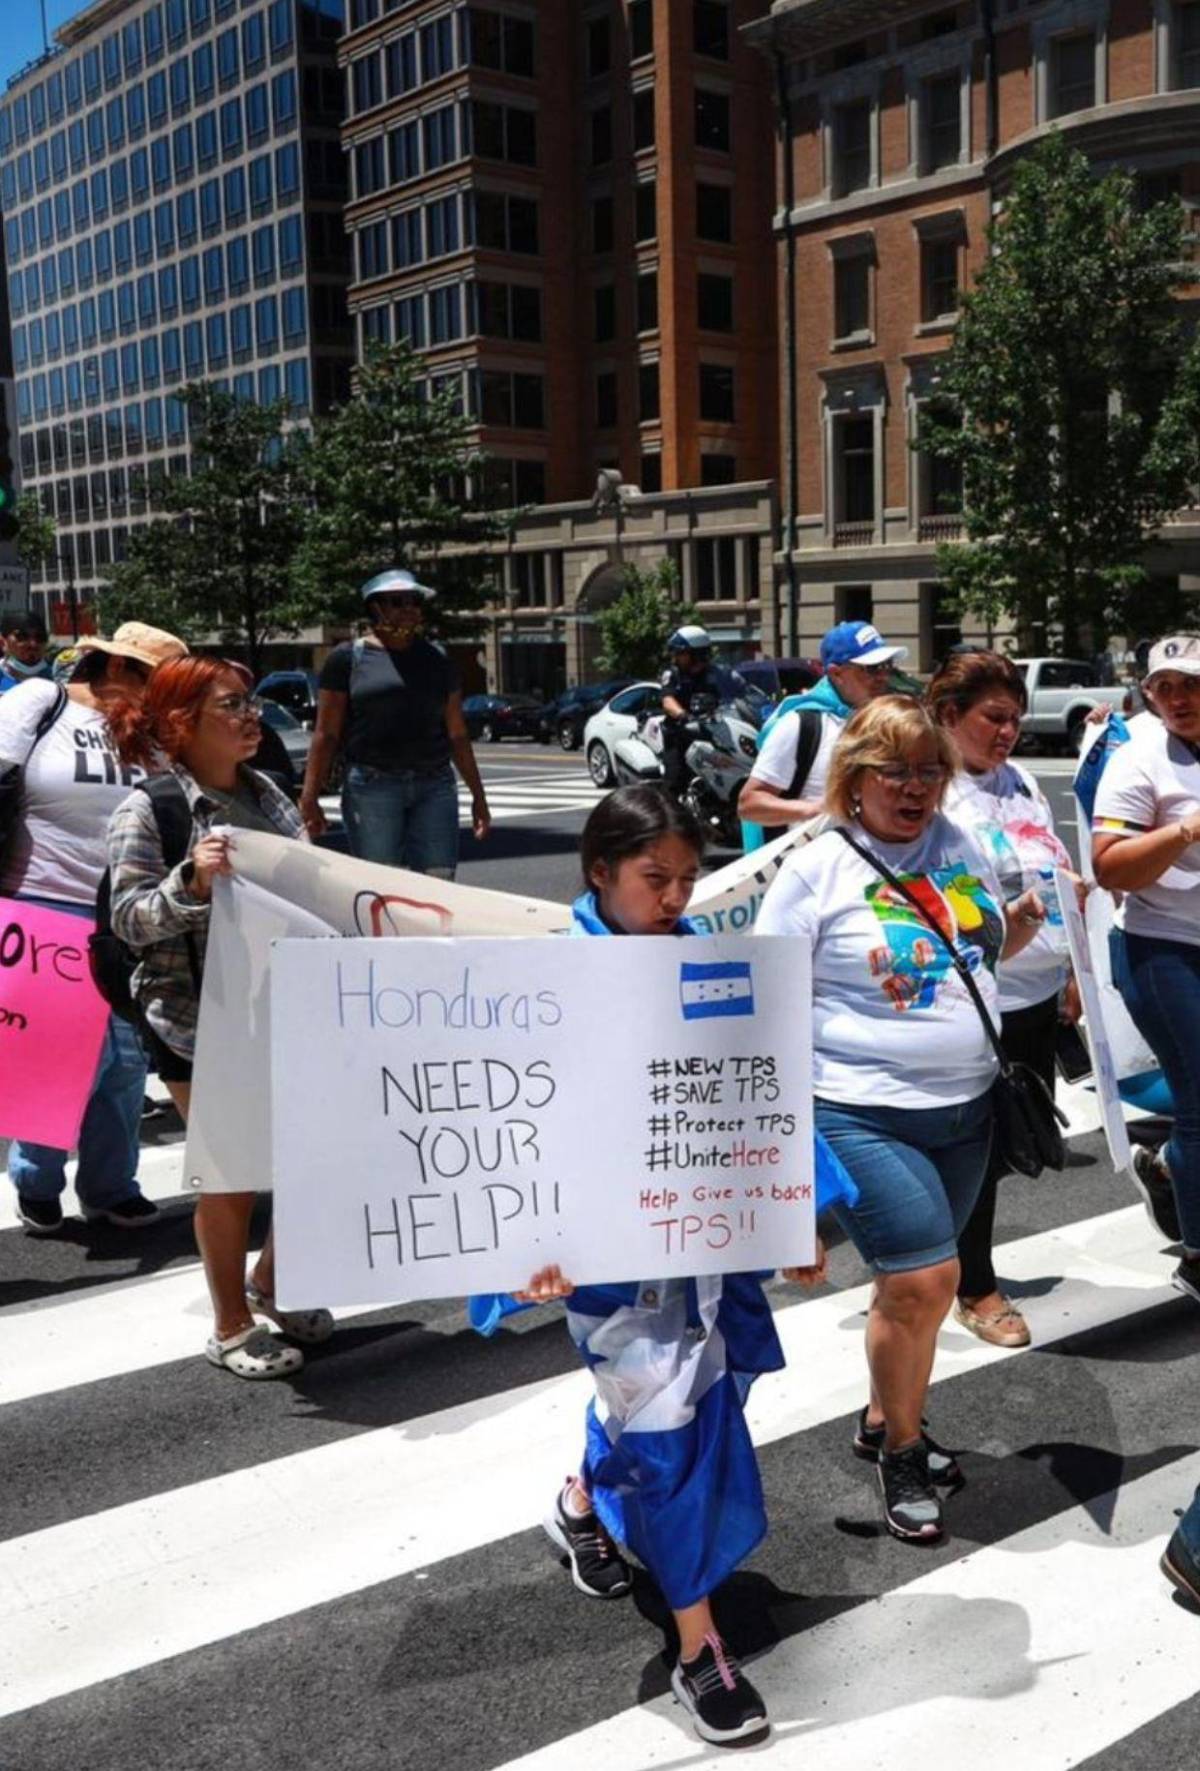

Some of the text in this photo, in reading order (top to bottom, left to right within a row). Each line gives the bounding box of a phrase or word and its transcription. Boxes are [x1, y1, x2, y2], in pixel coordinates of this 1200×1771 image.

[73, 728, 108, 750] CH
[692, 892, 765, 933] arol
[337, 959, 563, 1033] Honduras
[729, 1056, 776, 1077] TPS
[381, 1058, 556, 1116] NEEDS
[735, 1075, 781, 1102] TPS
[755, 1113, 796, 1136] TPS
[398, 1118, 541, 1184] YOUR
[640, 1183, 813, 1211] Help Give us back
[364, 1180, 562, 1269] HELP!!
